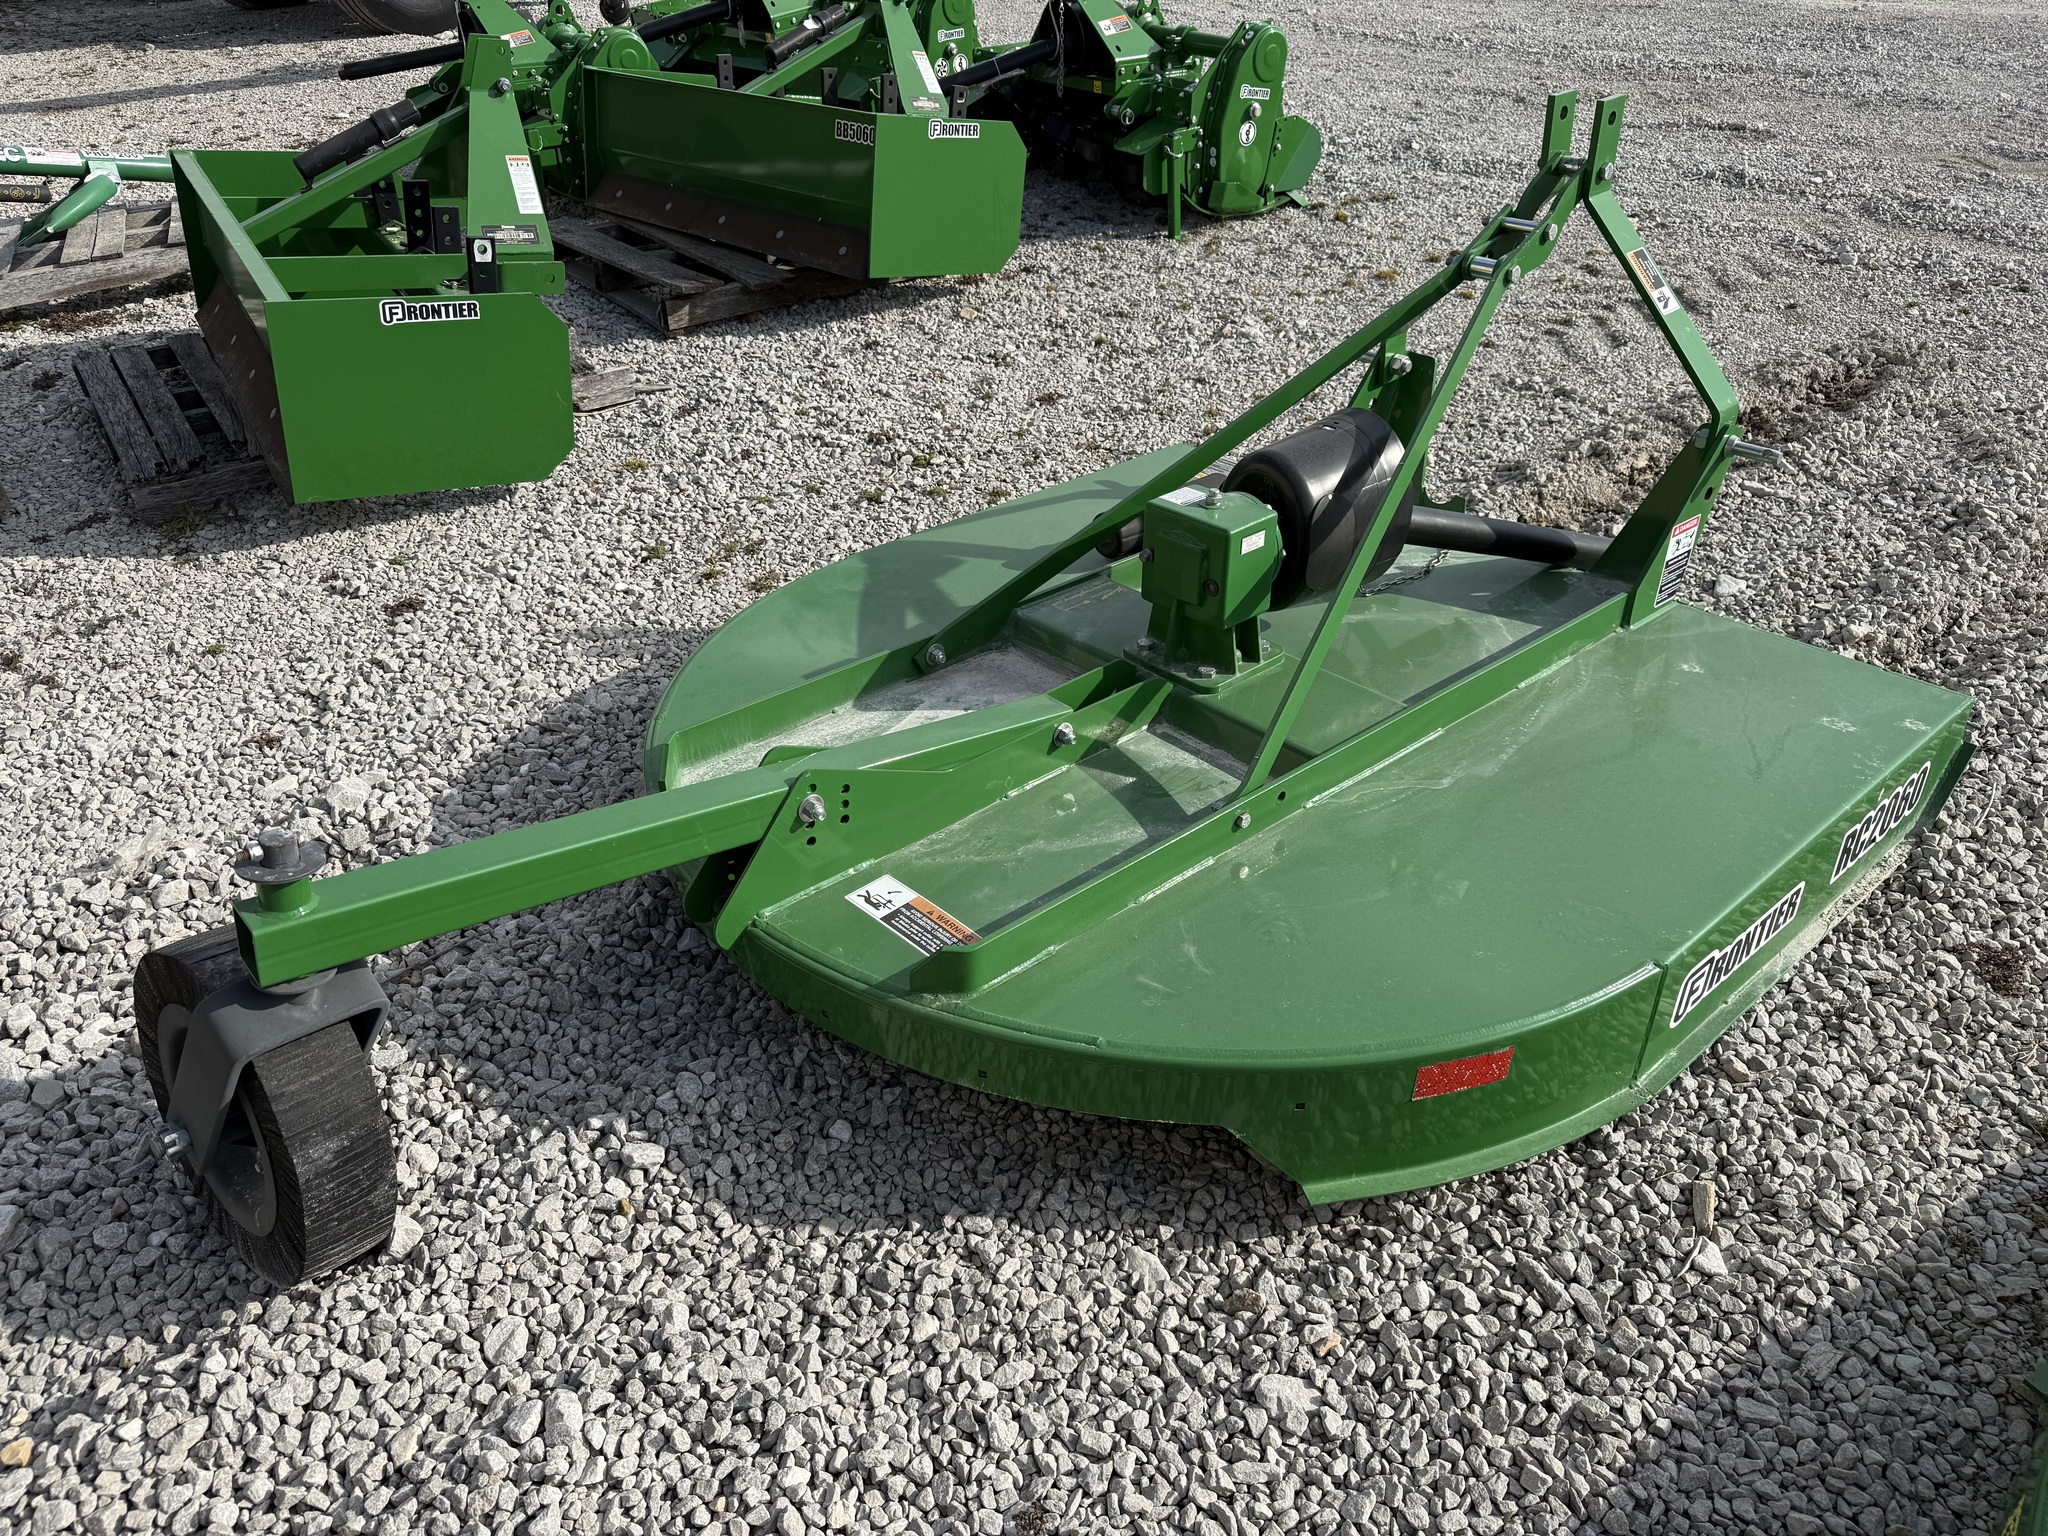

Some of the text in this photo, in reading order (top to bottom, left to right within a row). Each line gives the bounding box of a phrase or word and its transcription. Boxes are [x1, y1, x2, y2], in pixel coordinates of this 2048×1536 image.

[938, 29, 965, 41] FRONTIER
[1241, 85, 1270, 99] FRONTIER
[930, 120, 979, 138] FRONTIER
[381, 301, 479, 324] FRONTIER
[1832, 764, 1930, 880] RC2060
[935, 914, 975, 942] WARNING
[1672, 885, 1804, 1025] FRONTIER
